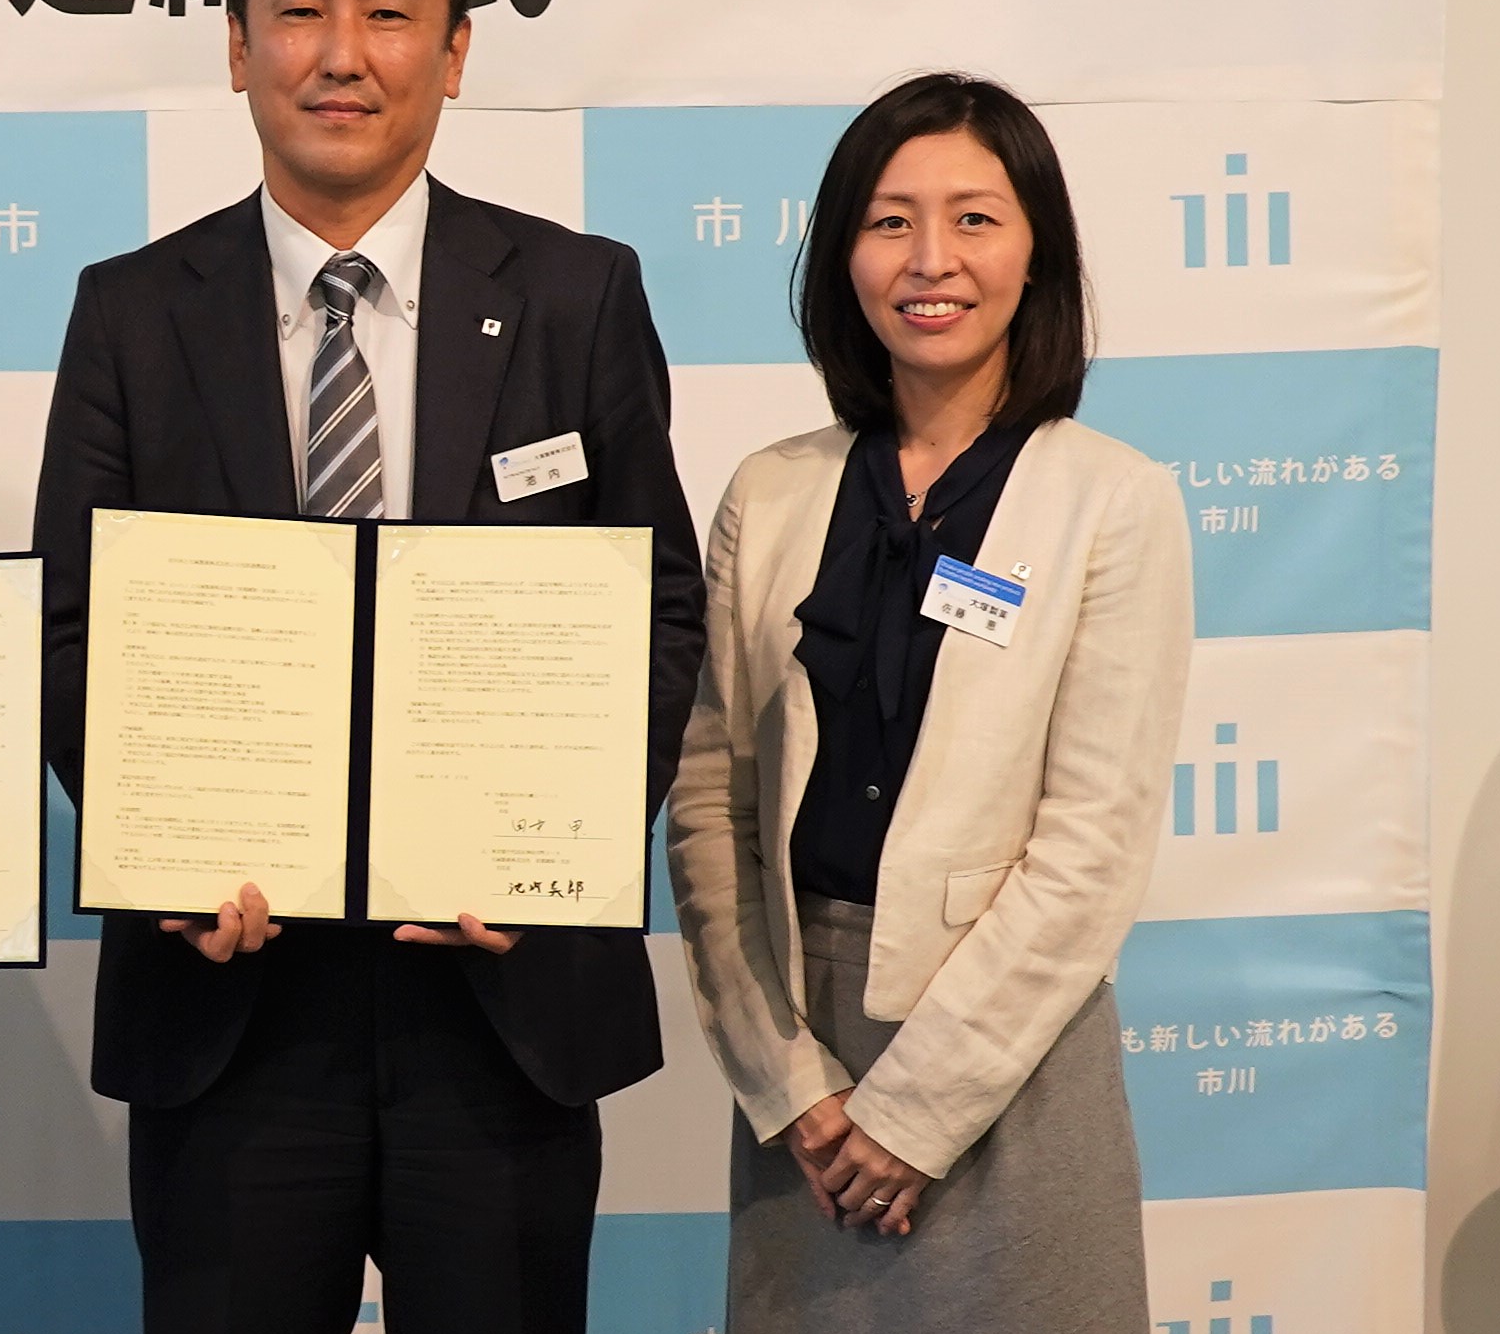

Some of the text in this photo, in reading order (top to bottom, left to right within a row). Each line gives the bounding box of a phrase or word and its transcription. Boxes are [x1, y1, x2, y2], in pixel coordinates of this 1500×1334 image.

[1200, 505, 1258, 534] 市川
[1121, 1012, 1398, 1053] も新しい流れがある
[1197, 1067, 1256, 1096] 市川
